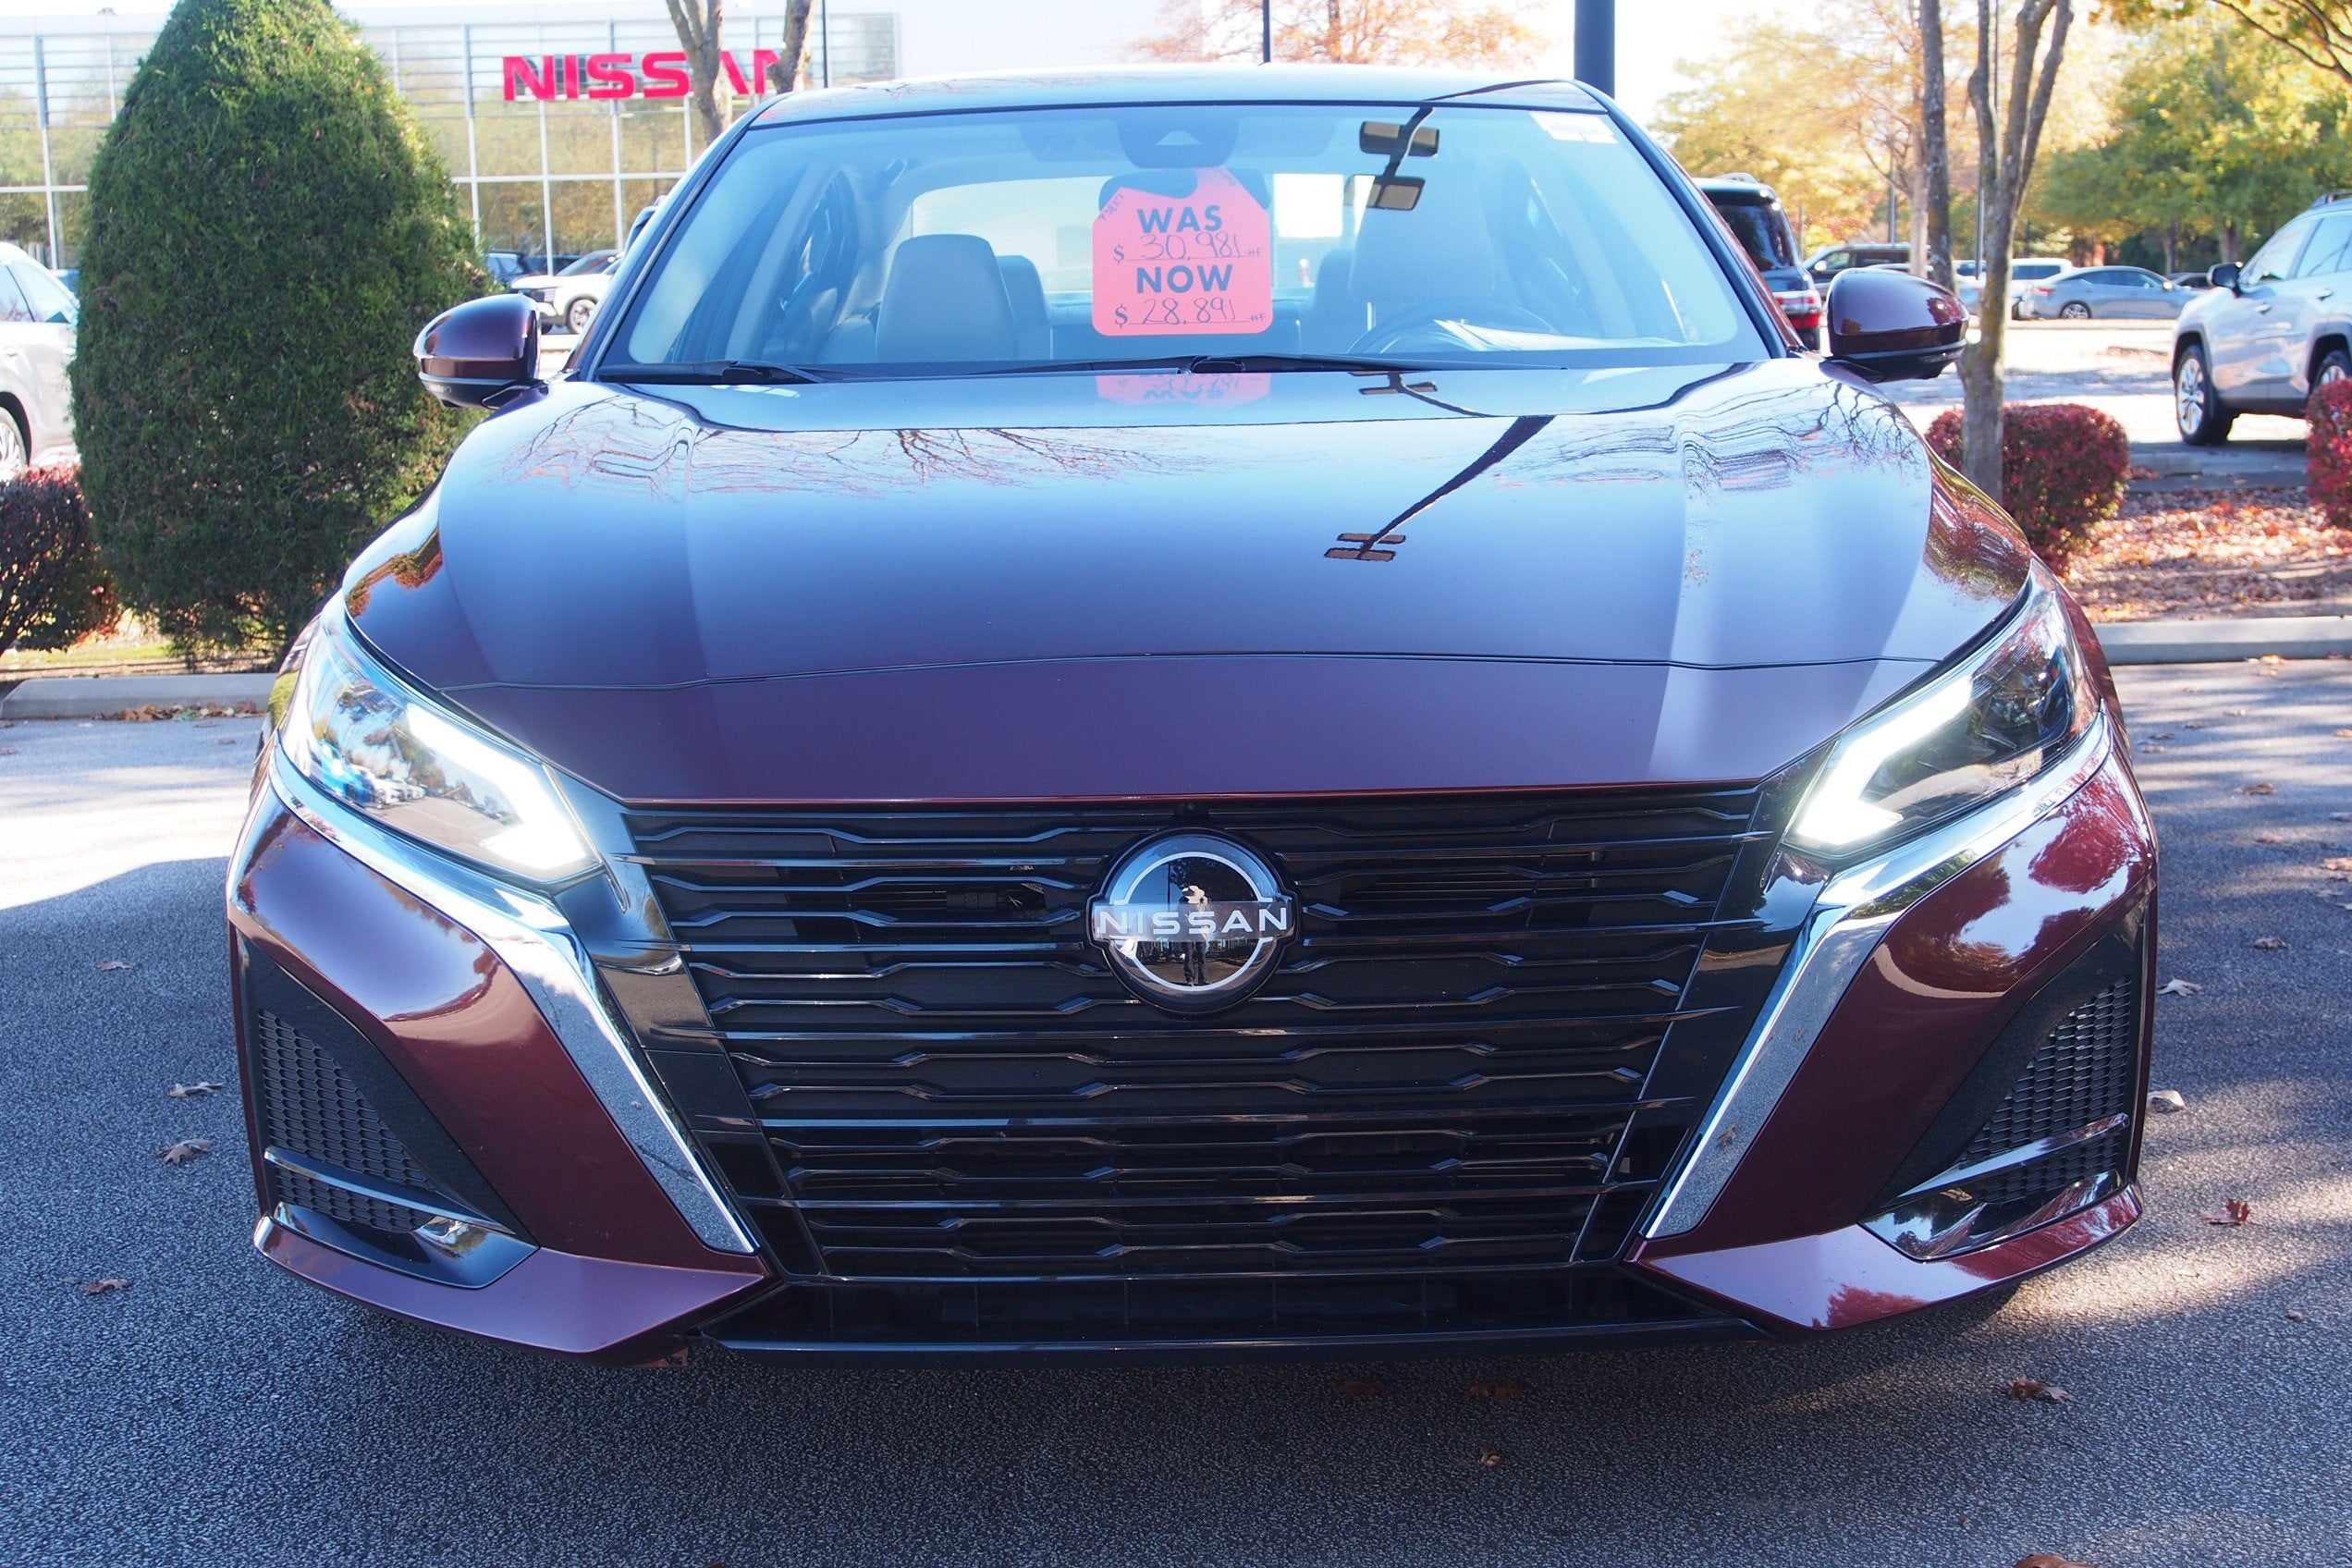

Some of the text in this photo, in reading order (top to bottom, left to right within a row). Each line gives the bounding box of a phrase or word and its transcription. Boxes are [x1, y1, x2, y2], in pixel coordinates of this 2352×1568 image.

[1137, 204, 1222, 233] WAS
[1137, 264, 1233, 293] NOW
[1098, 907, 1288, 935] NISSAN
